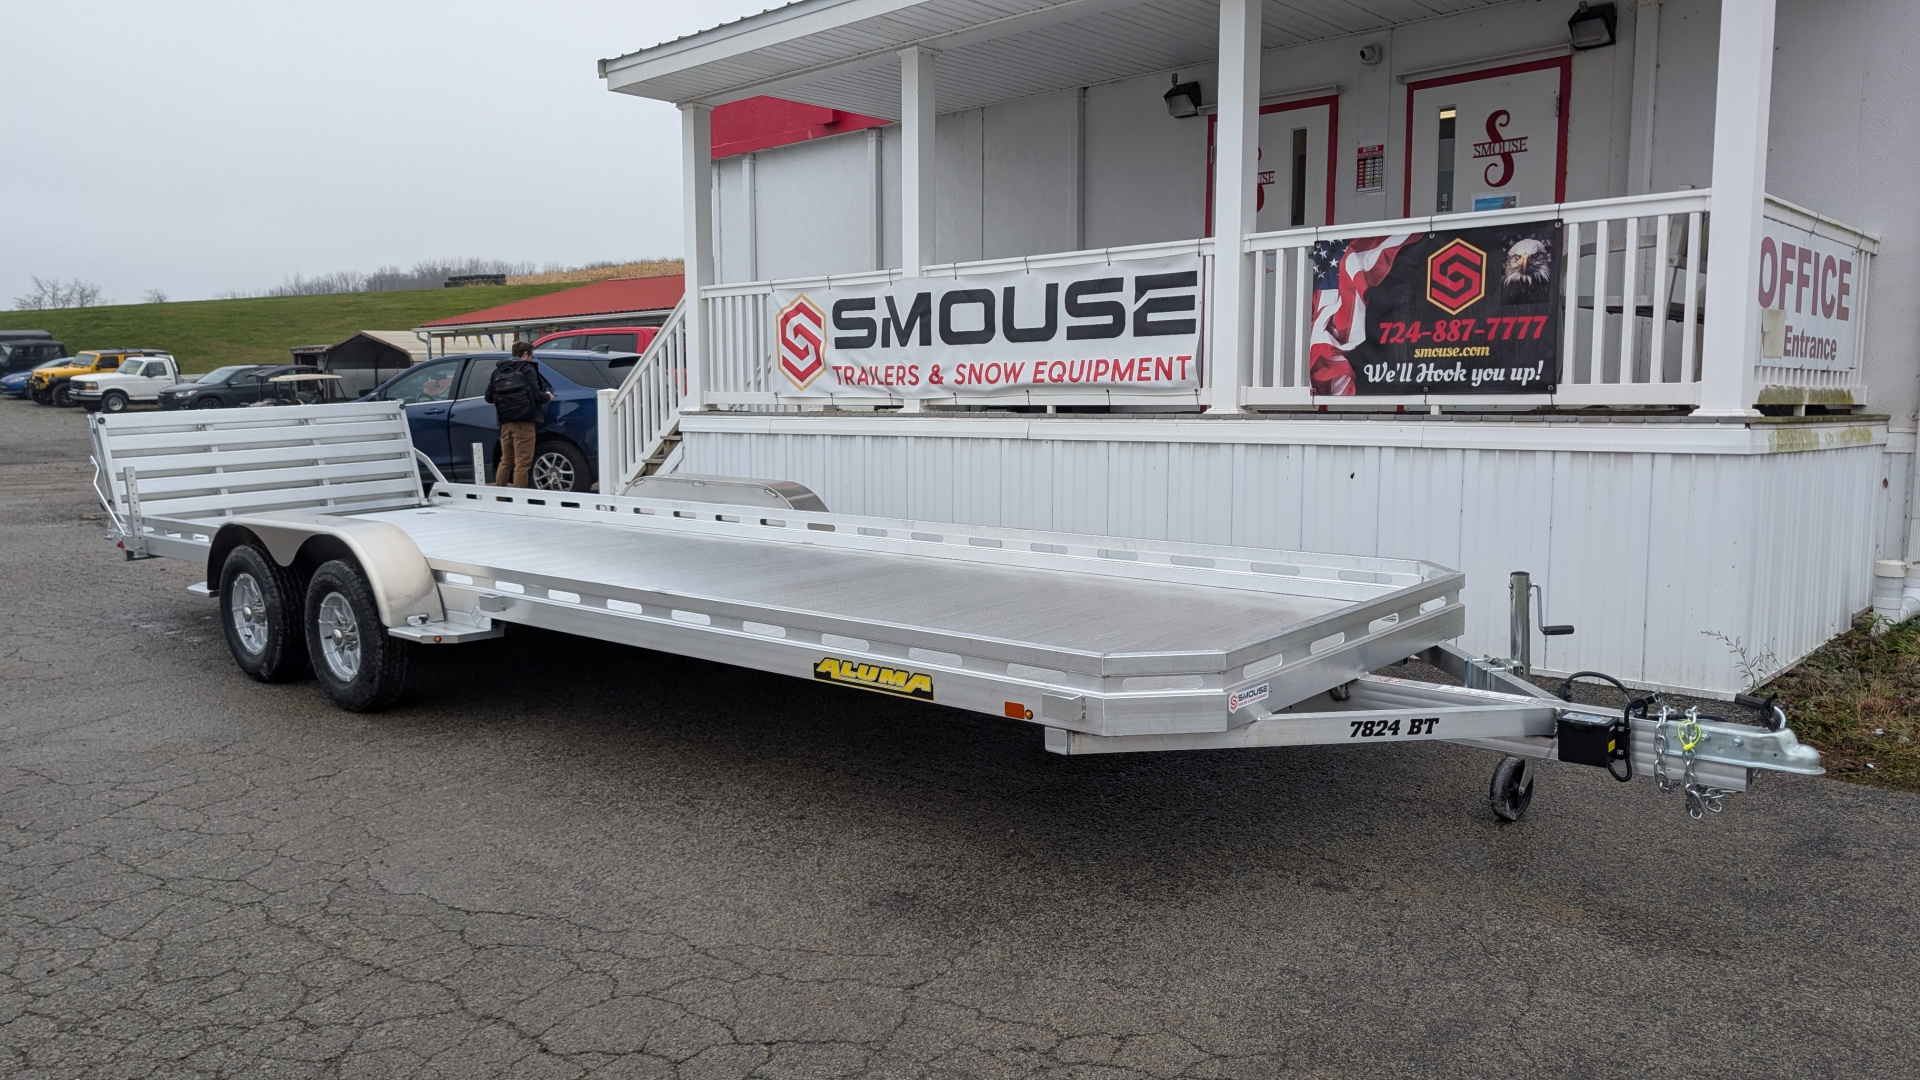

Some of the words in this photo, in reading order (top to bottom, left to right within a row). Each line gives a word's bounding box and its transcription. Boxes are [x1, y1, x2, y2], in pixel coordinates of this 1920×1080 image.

[1473, 138, 1528, 157] SMOUSE
[1758, 236, 1852, 321] OFFICE
[832, 270, 1198, 350] SMOUSE
[1379, 316, 1548, 344] 724-887-7777
[1783, 325, 1837, 360] Entrance
[1413, 345, 1490, 358] smouse.com
[832, 365, 920, 386] TRAILERS
[928, 364, 944, 385] &
[953, 361, 1026, 386] SNOW
[1032, 355, 1192, 384] EQUIPMENT
[1363, 361, 1413, 383] We'll
[1416, 361, 1467, 383] Hook
[1471, 366, 1506, 387] you
[1510, 360, 1544, 386] up!
[815, 658, 932, 693] ALUMA
[1238, 684, 1268, 702] SMOUSE
[1350, 719, 1401, 738] 7824
[1407, 718, 1440, 735] BT
